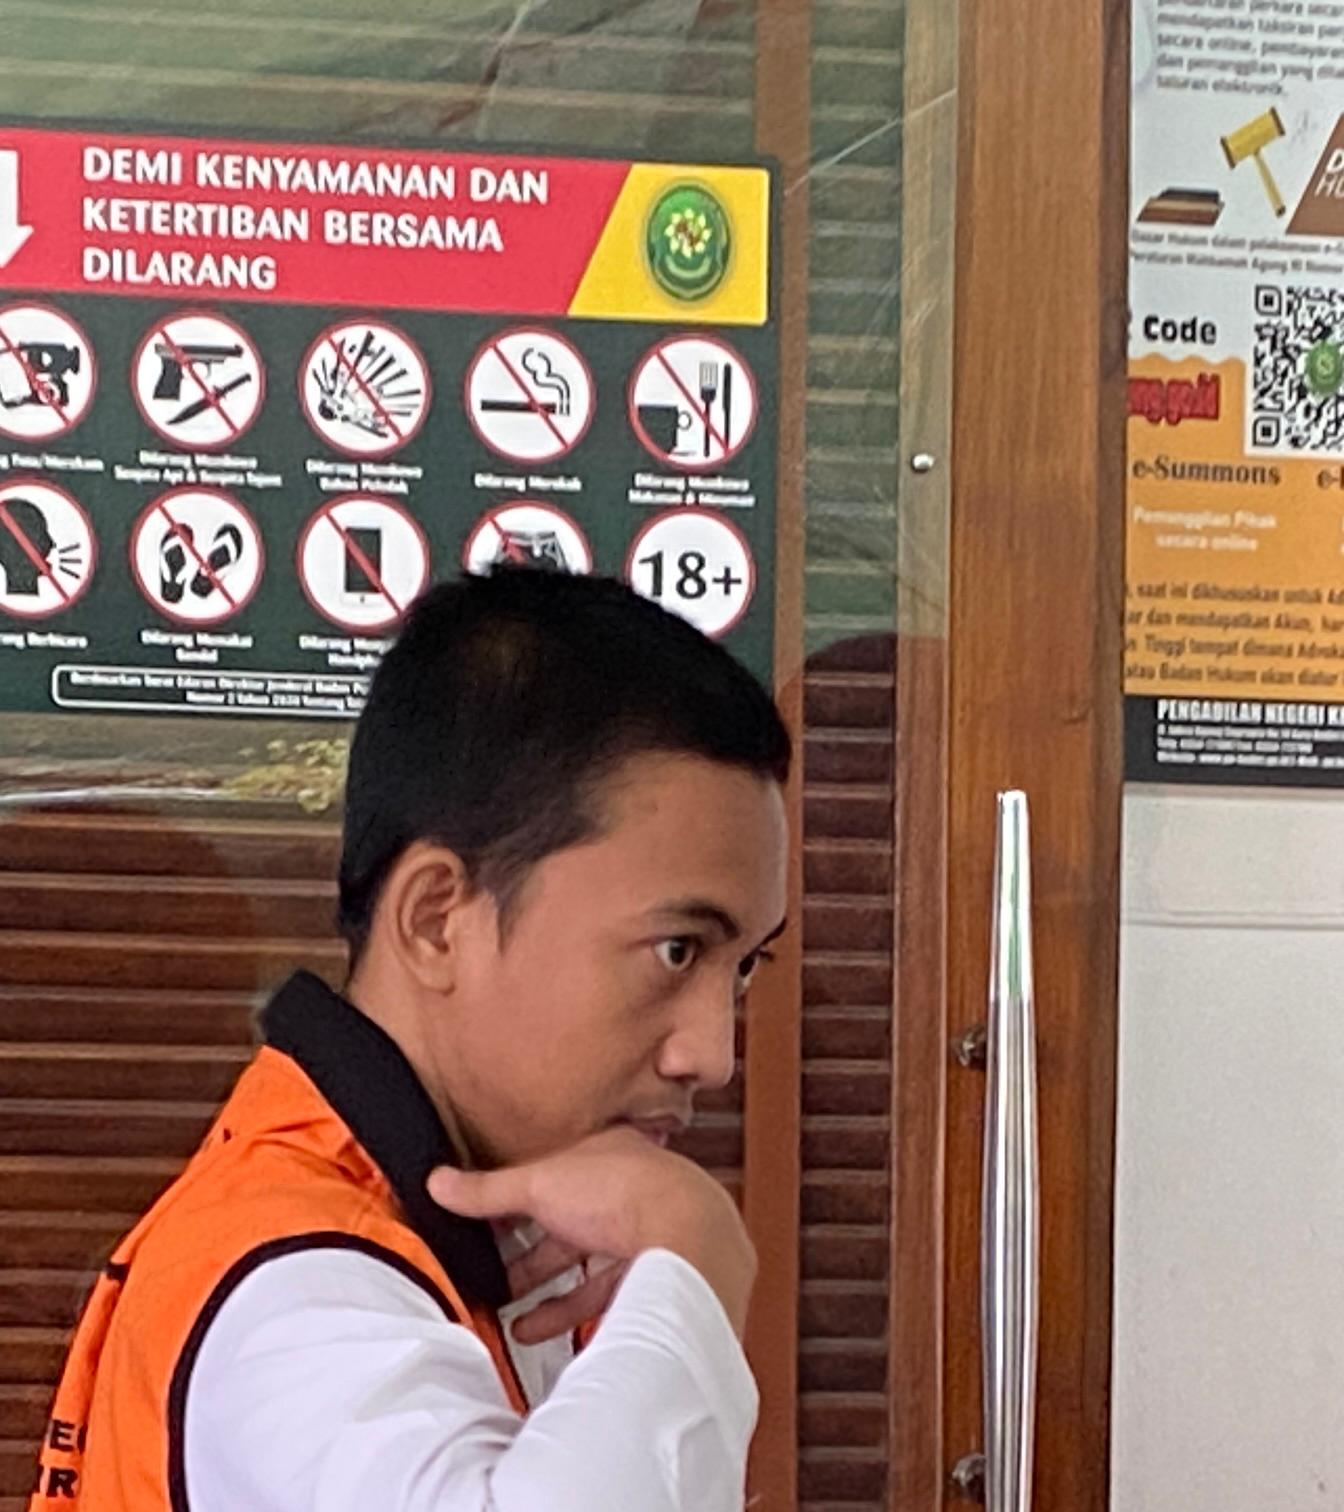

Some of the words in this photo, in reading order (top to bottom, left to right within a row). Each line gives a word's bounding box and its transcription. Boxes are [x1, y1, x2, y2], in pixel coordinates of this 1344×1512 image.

[83, 147, 182, 186] DEMI
[196, 153, 456, 199] KENYAMANAN
[469, 167, 549, 203] DAN
[82, 198, 309, 242] KETERTIBAN
[323, 209, 504, 252] BERSAMA
[82, 247, 278, 291] DILARANG
[1142, 314, 1218, 345] Code
[1132, 456, 1281, 487] e-Summons
[638, 550, 742, 600] 18+
[1157, 699, 1262, 723] PENGADILAN
